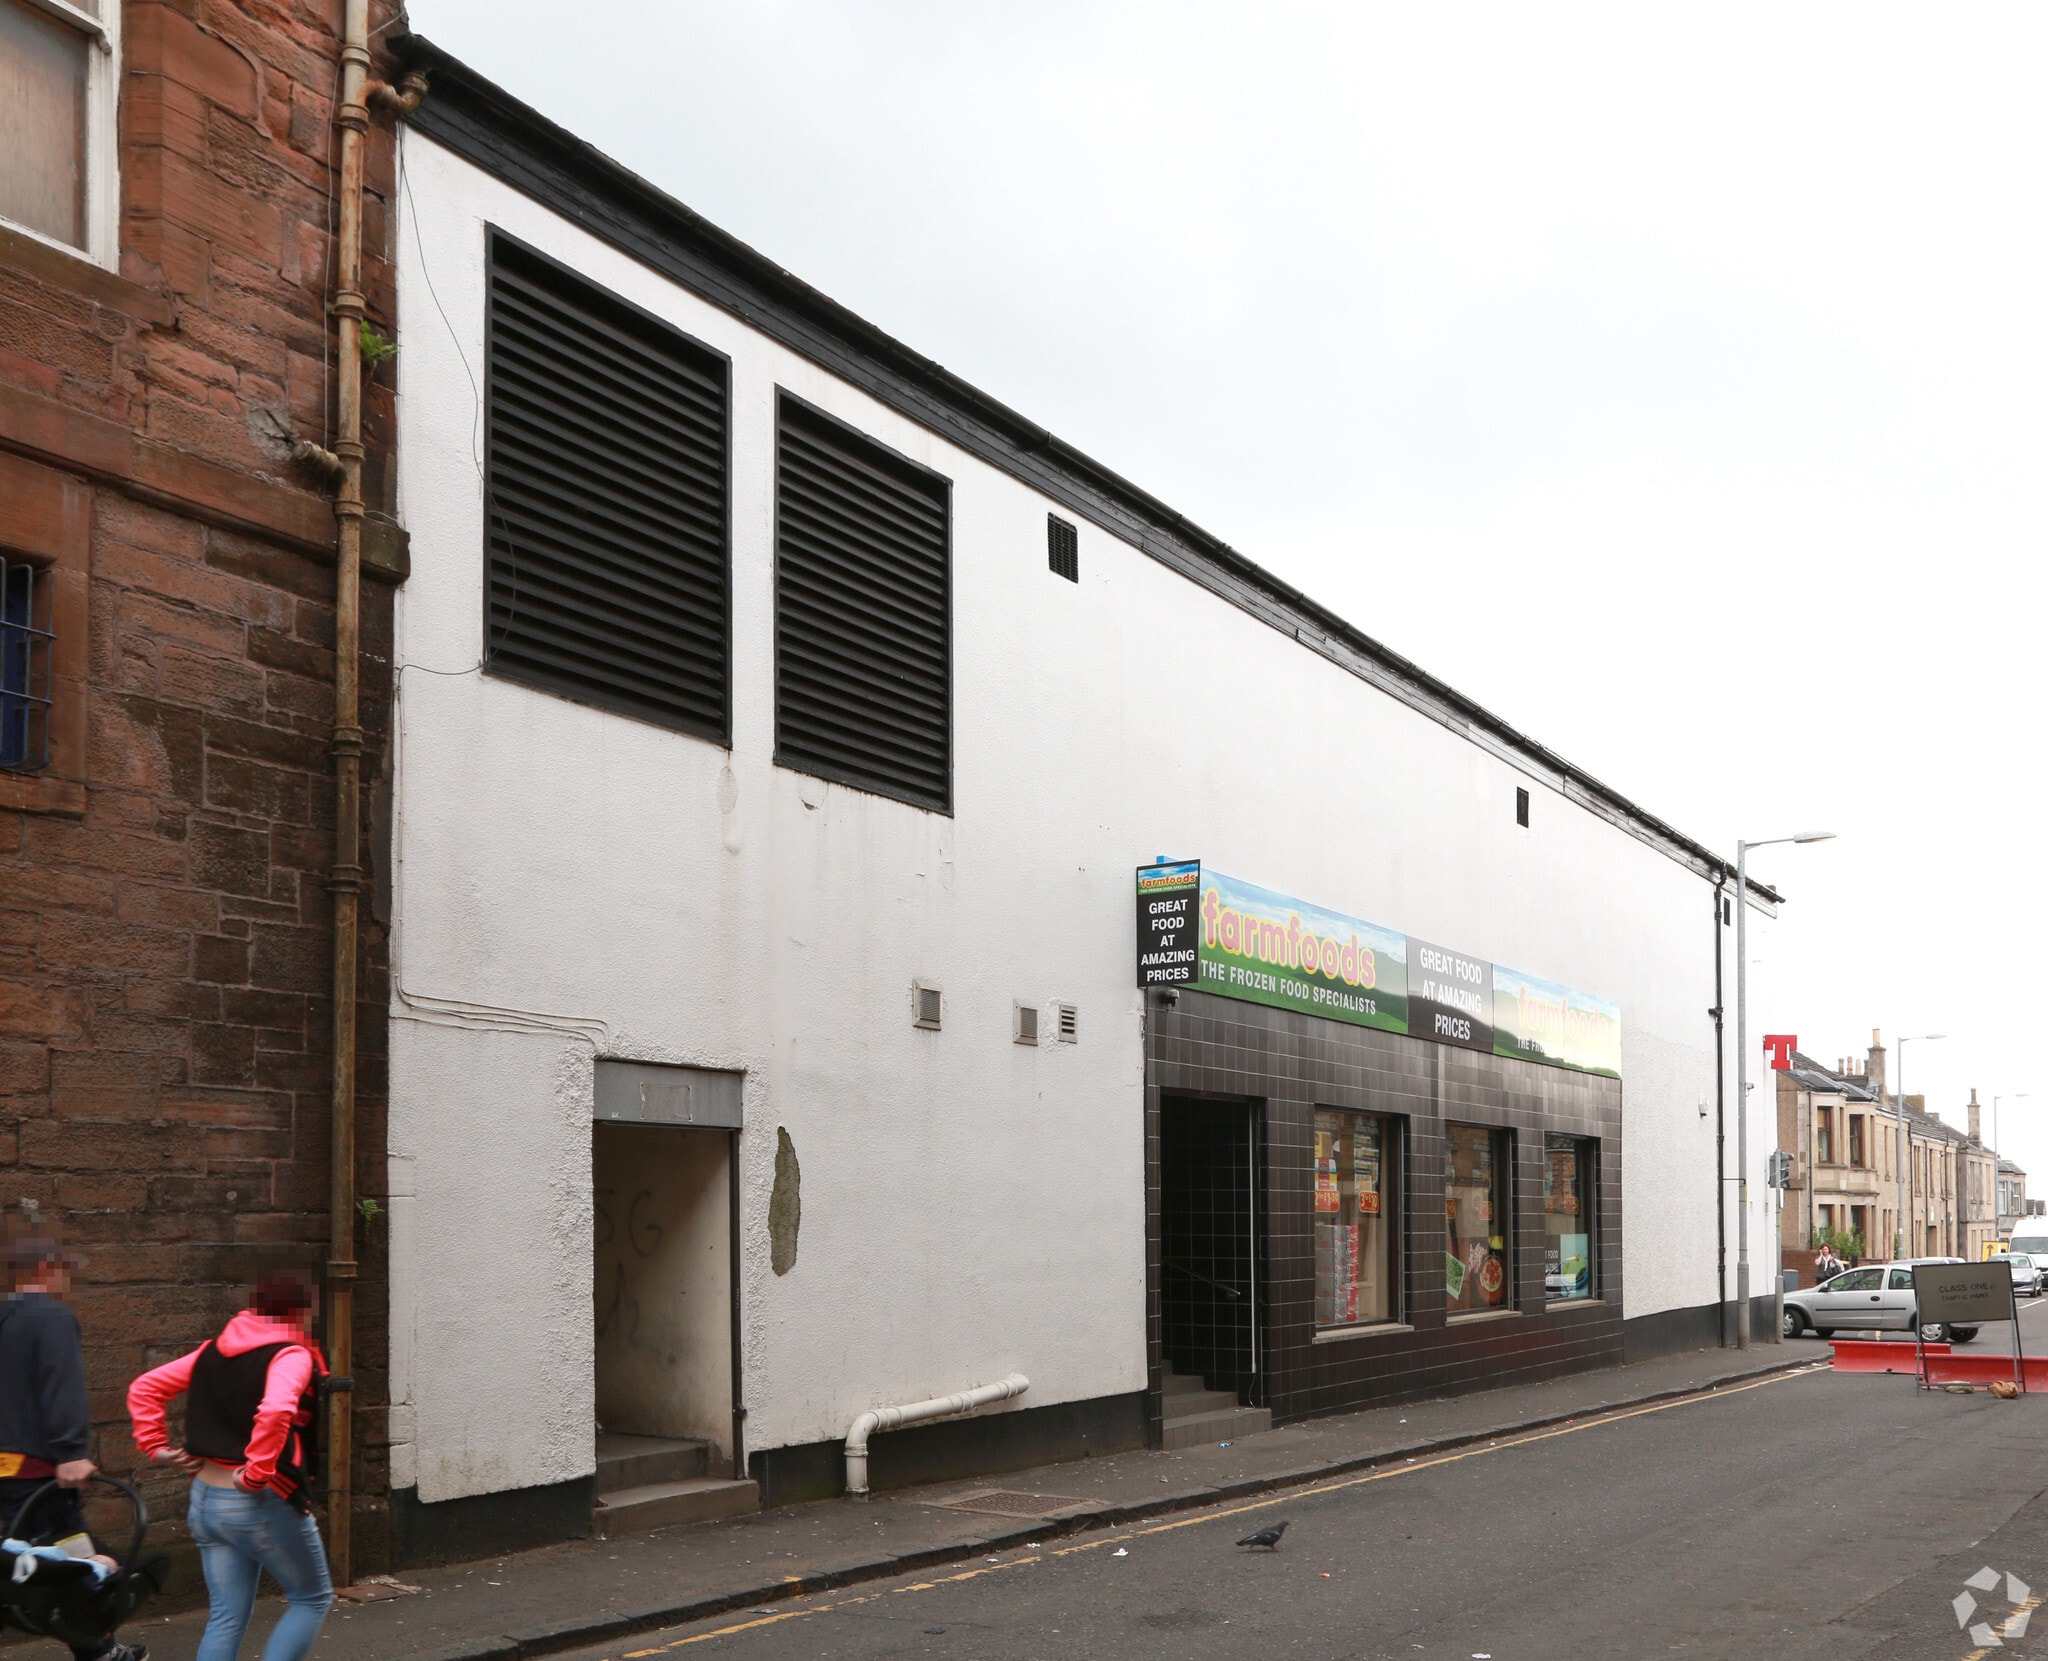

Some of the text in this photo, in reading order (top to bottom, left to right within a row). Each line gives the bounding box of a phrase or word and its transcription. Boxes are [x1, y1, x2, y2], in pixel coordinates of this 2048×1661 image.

[1141, 873, 1197, 888] farmfoods
[1149, 899, 1188, 914] GREAT
[1151, 917, 1185, 931] FOOD
[1160, 934, 1176, 947] AT
[1202, 886, 1376, 990] farmfoods
[1140, 949, 1195, 966] AMAZING
[1146, 966, 1189, 982] PRICES
[1420, 947, 1482, 985] GREAT FOOD
[1201, 959, 1376, 1015] THE FROZEN FOOD SPECIALISTS
[1422, 979, 1482, 1014] AT AMAZING
[1434, 1013, 1471, 1041] PRICES
[1517, 1036, 1530, 1051] THE
[1763, 1034, 1798, 1071] T
[1360, 1193, 1365, 1207] 3
[1939, 1282, 1989, 1293] CLASS ONE
